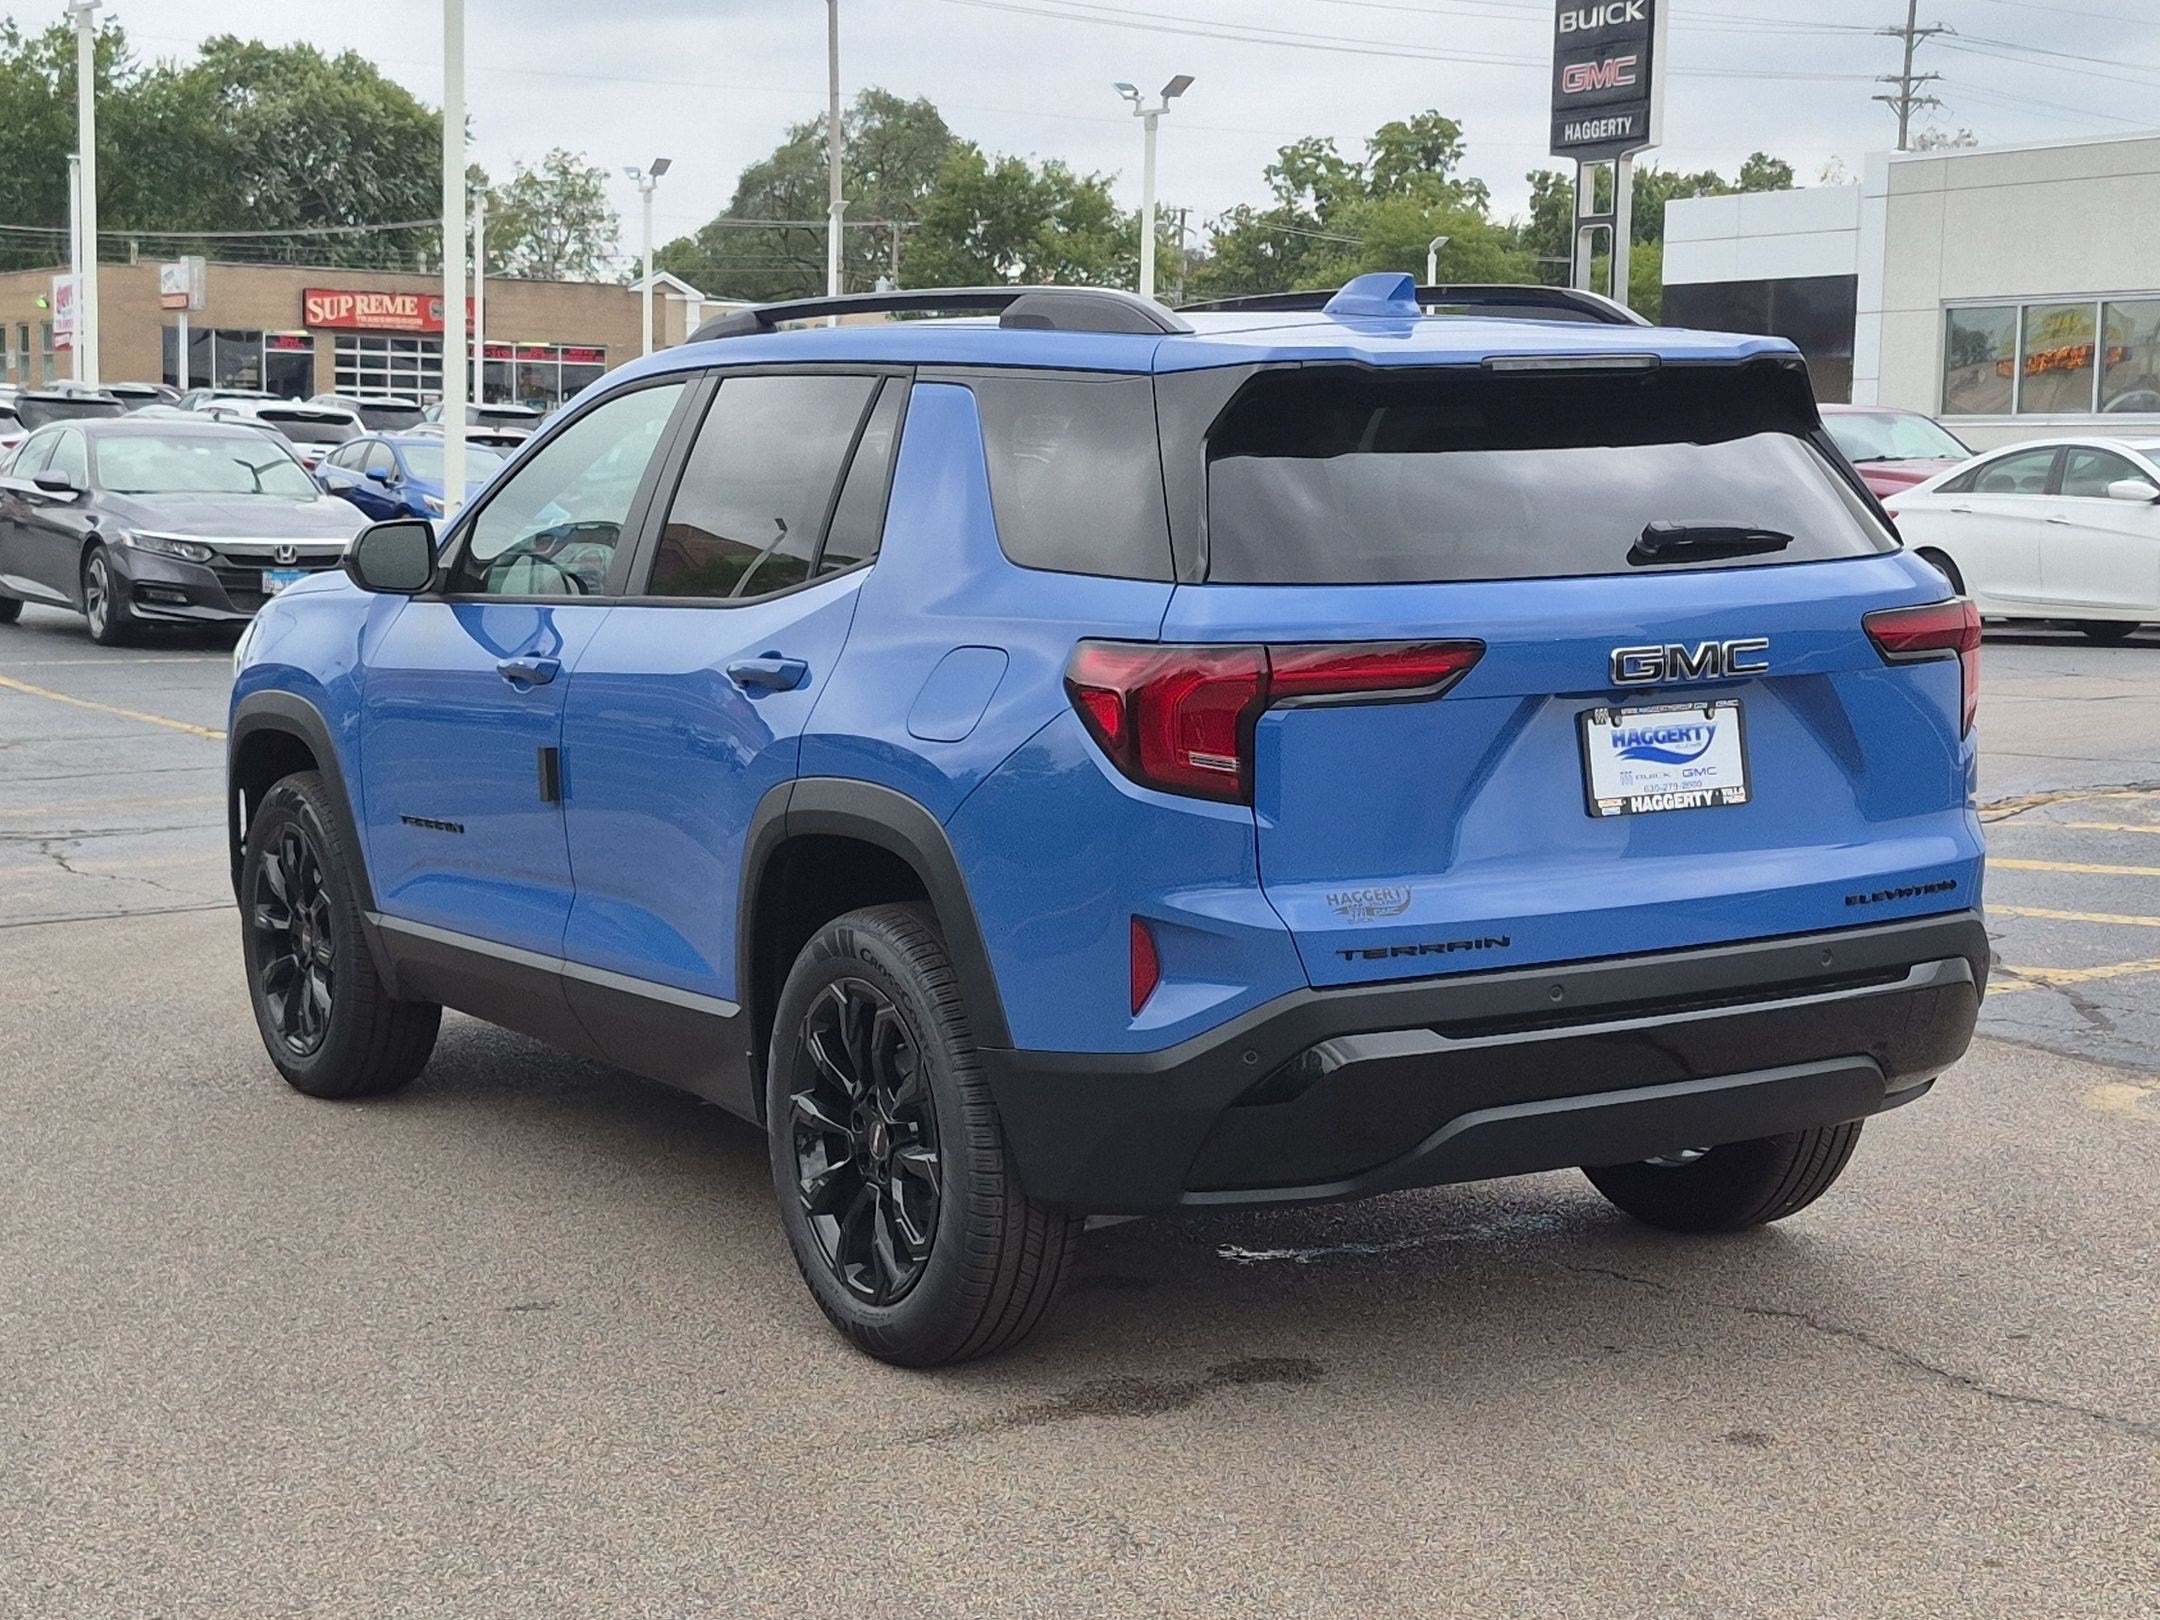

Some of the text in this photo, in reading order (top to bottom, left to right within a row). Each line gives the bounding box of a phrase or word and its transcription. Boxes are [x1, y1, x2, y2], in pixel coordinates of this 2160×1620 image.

[1560, 0, 1646, 33] BUICK
[1562, 55, 1637, 93] GMC
[1565, 116, 1632, 141] HAGGERTY
[308, 294, 418, 323] SUPREME
[1611, 637, 1769, 685] GMC
[1611, 722, 1717, 748] HAGGERTY
[1682, 766, 1718, 778] GMC
[1631, 788, 1714, 813] HAGGERTY
[1326, 885, 1412, 906] HAGGERTY
[1336, 934, 1511, 961] TERRAIN
